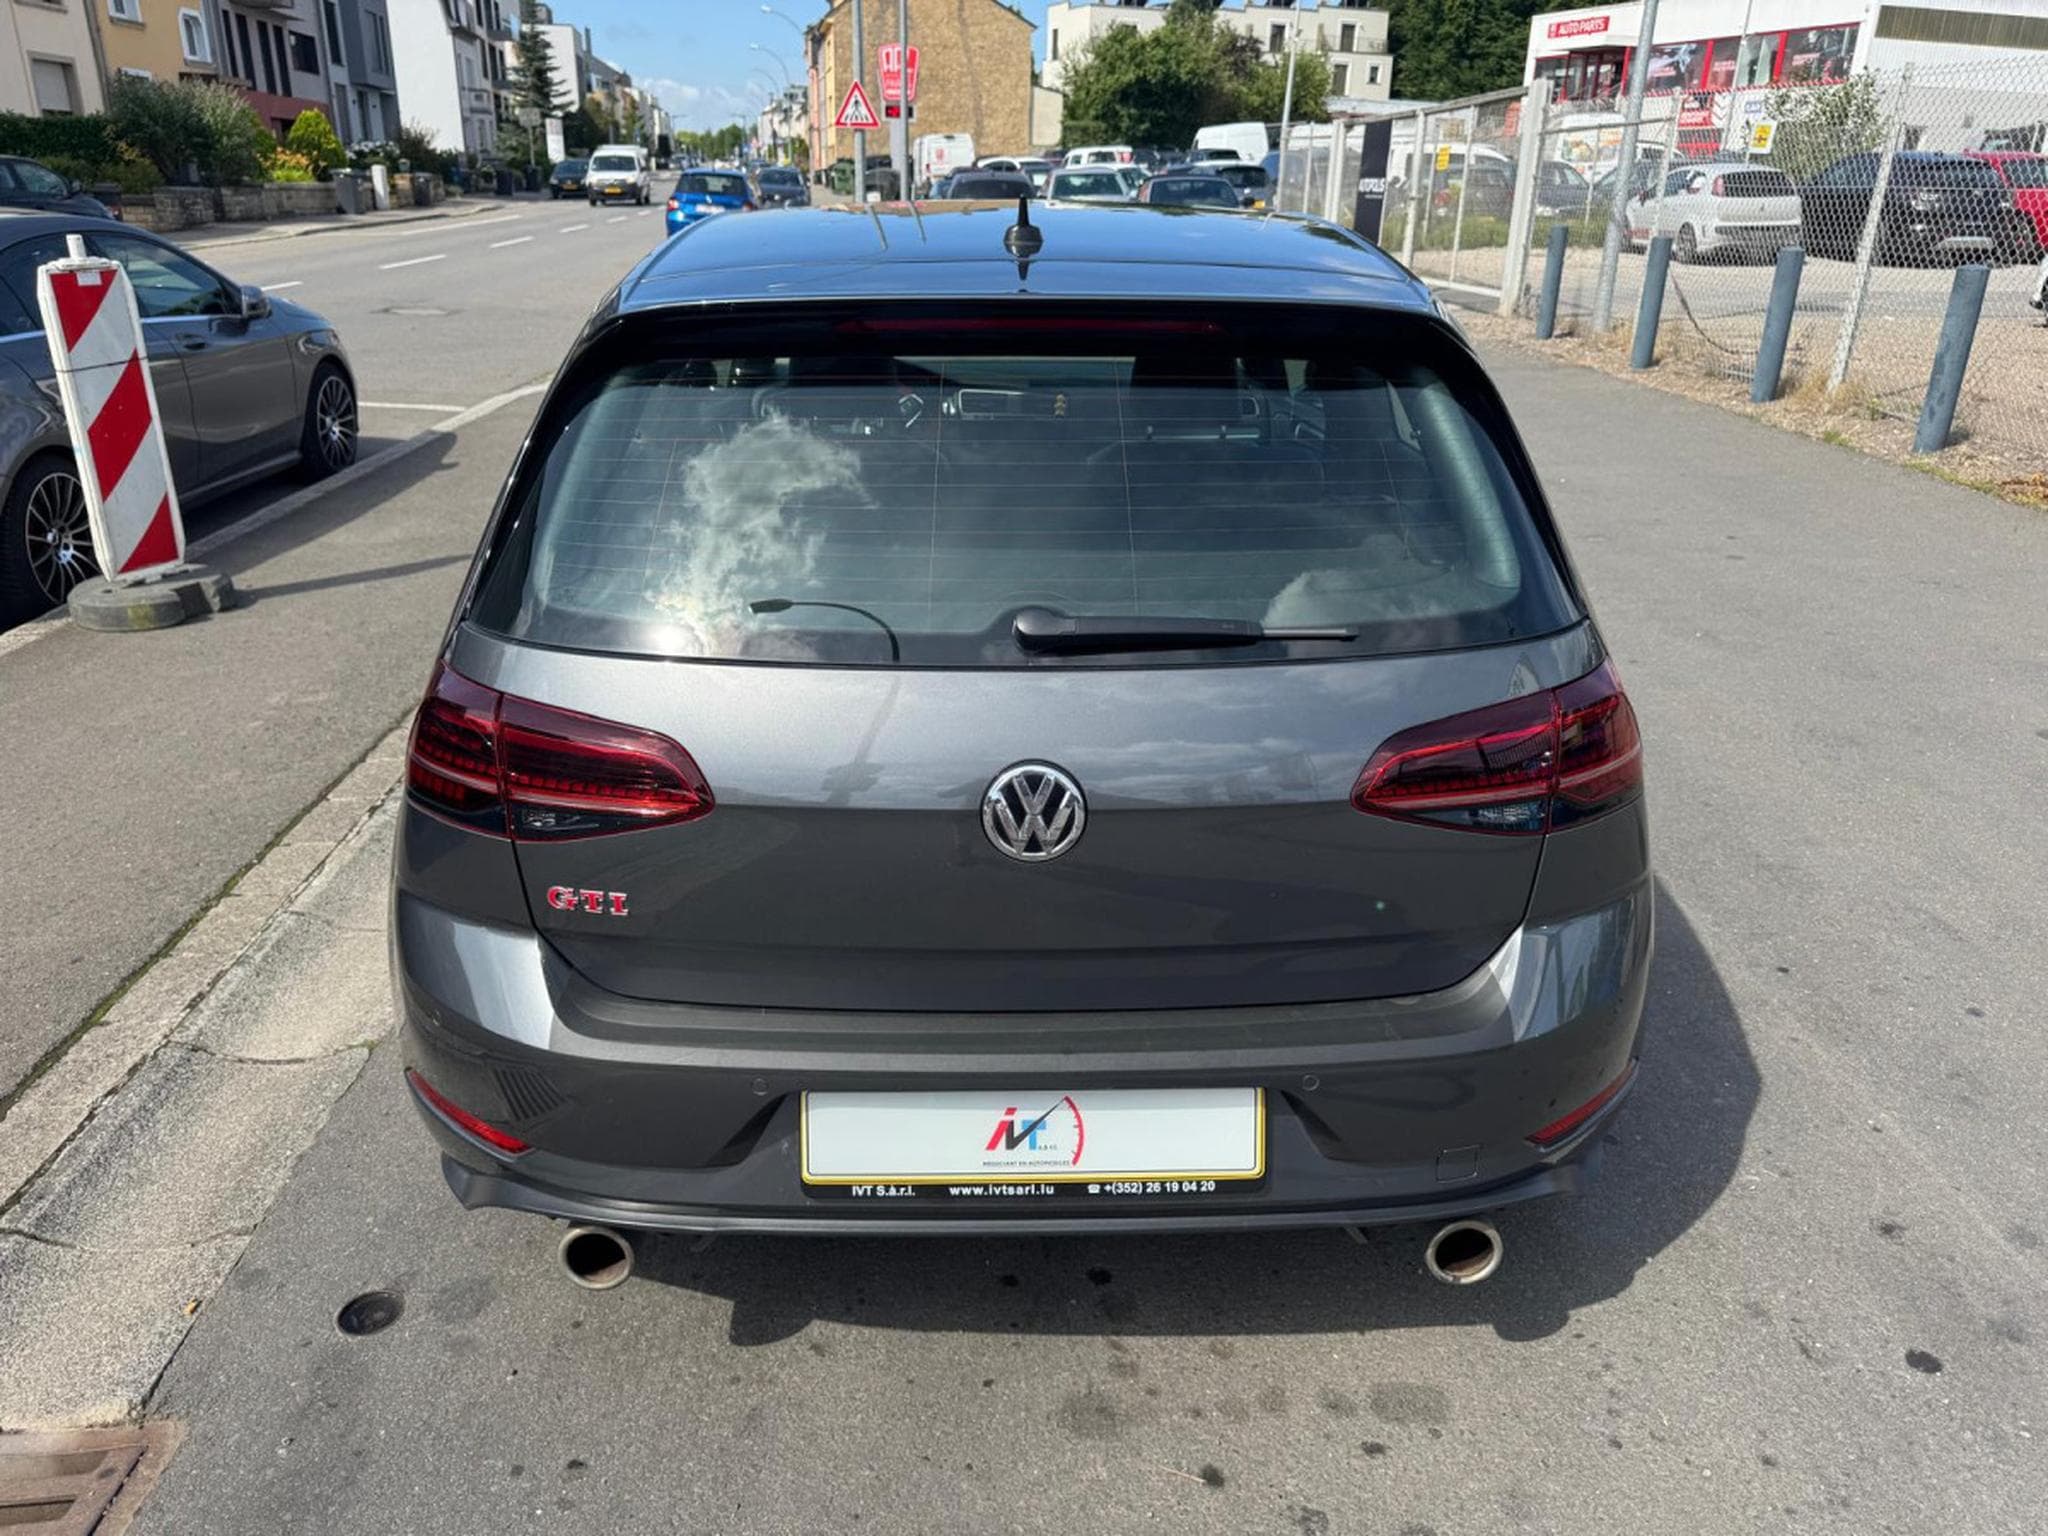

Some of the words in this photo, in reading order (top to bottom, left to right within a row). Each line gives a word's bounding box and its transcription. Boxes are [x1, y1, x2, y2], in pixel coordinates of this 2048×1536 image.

[547, 885, 629, 915] GTI
[852, 1185, 873, 1197] IVT
[949, 1184, 1055, 1196] www.ivtsarl.lu
[1104, 1181, 1143, 1195] +(352)
[1145, 1181, 1162, 1193] 26
[1165, 1181, 1180, 1192] 19
[1182, 1180, 1198, 1192] 04
[1200, 1180, 1216, 1192] 20
